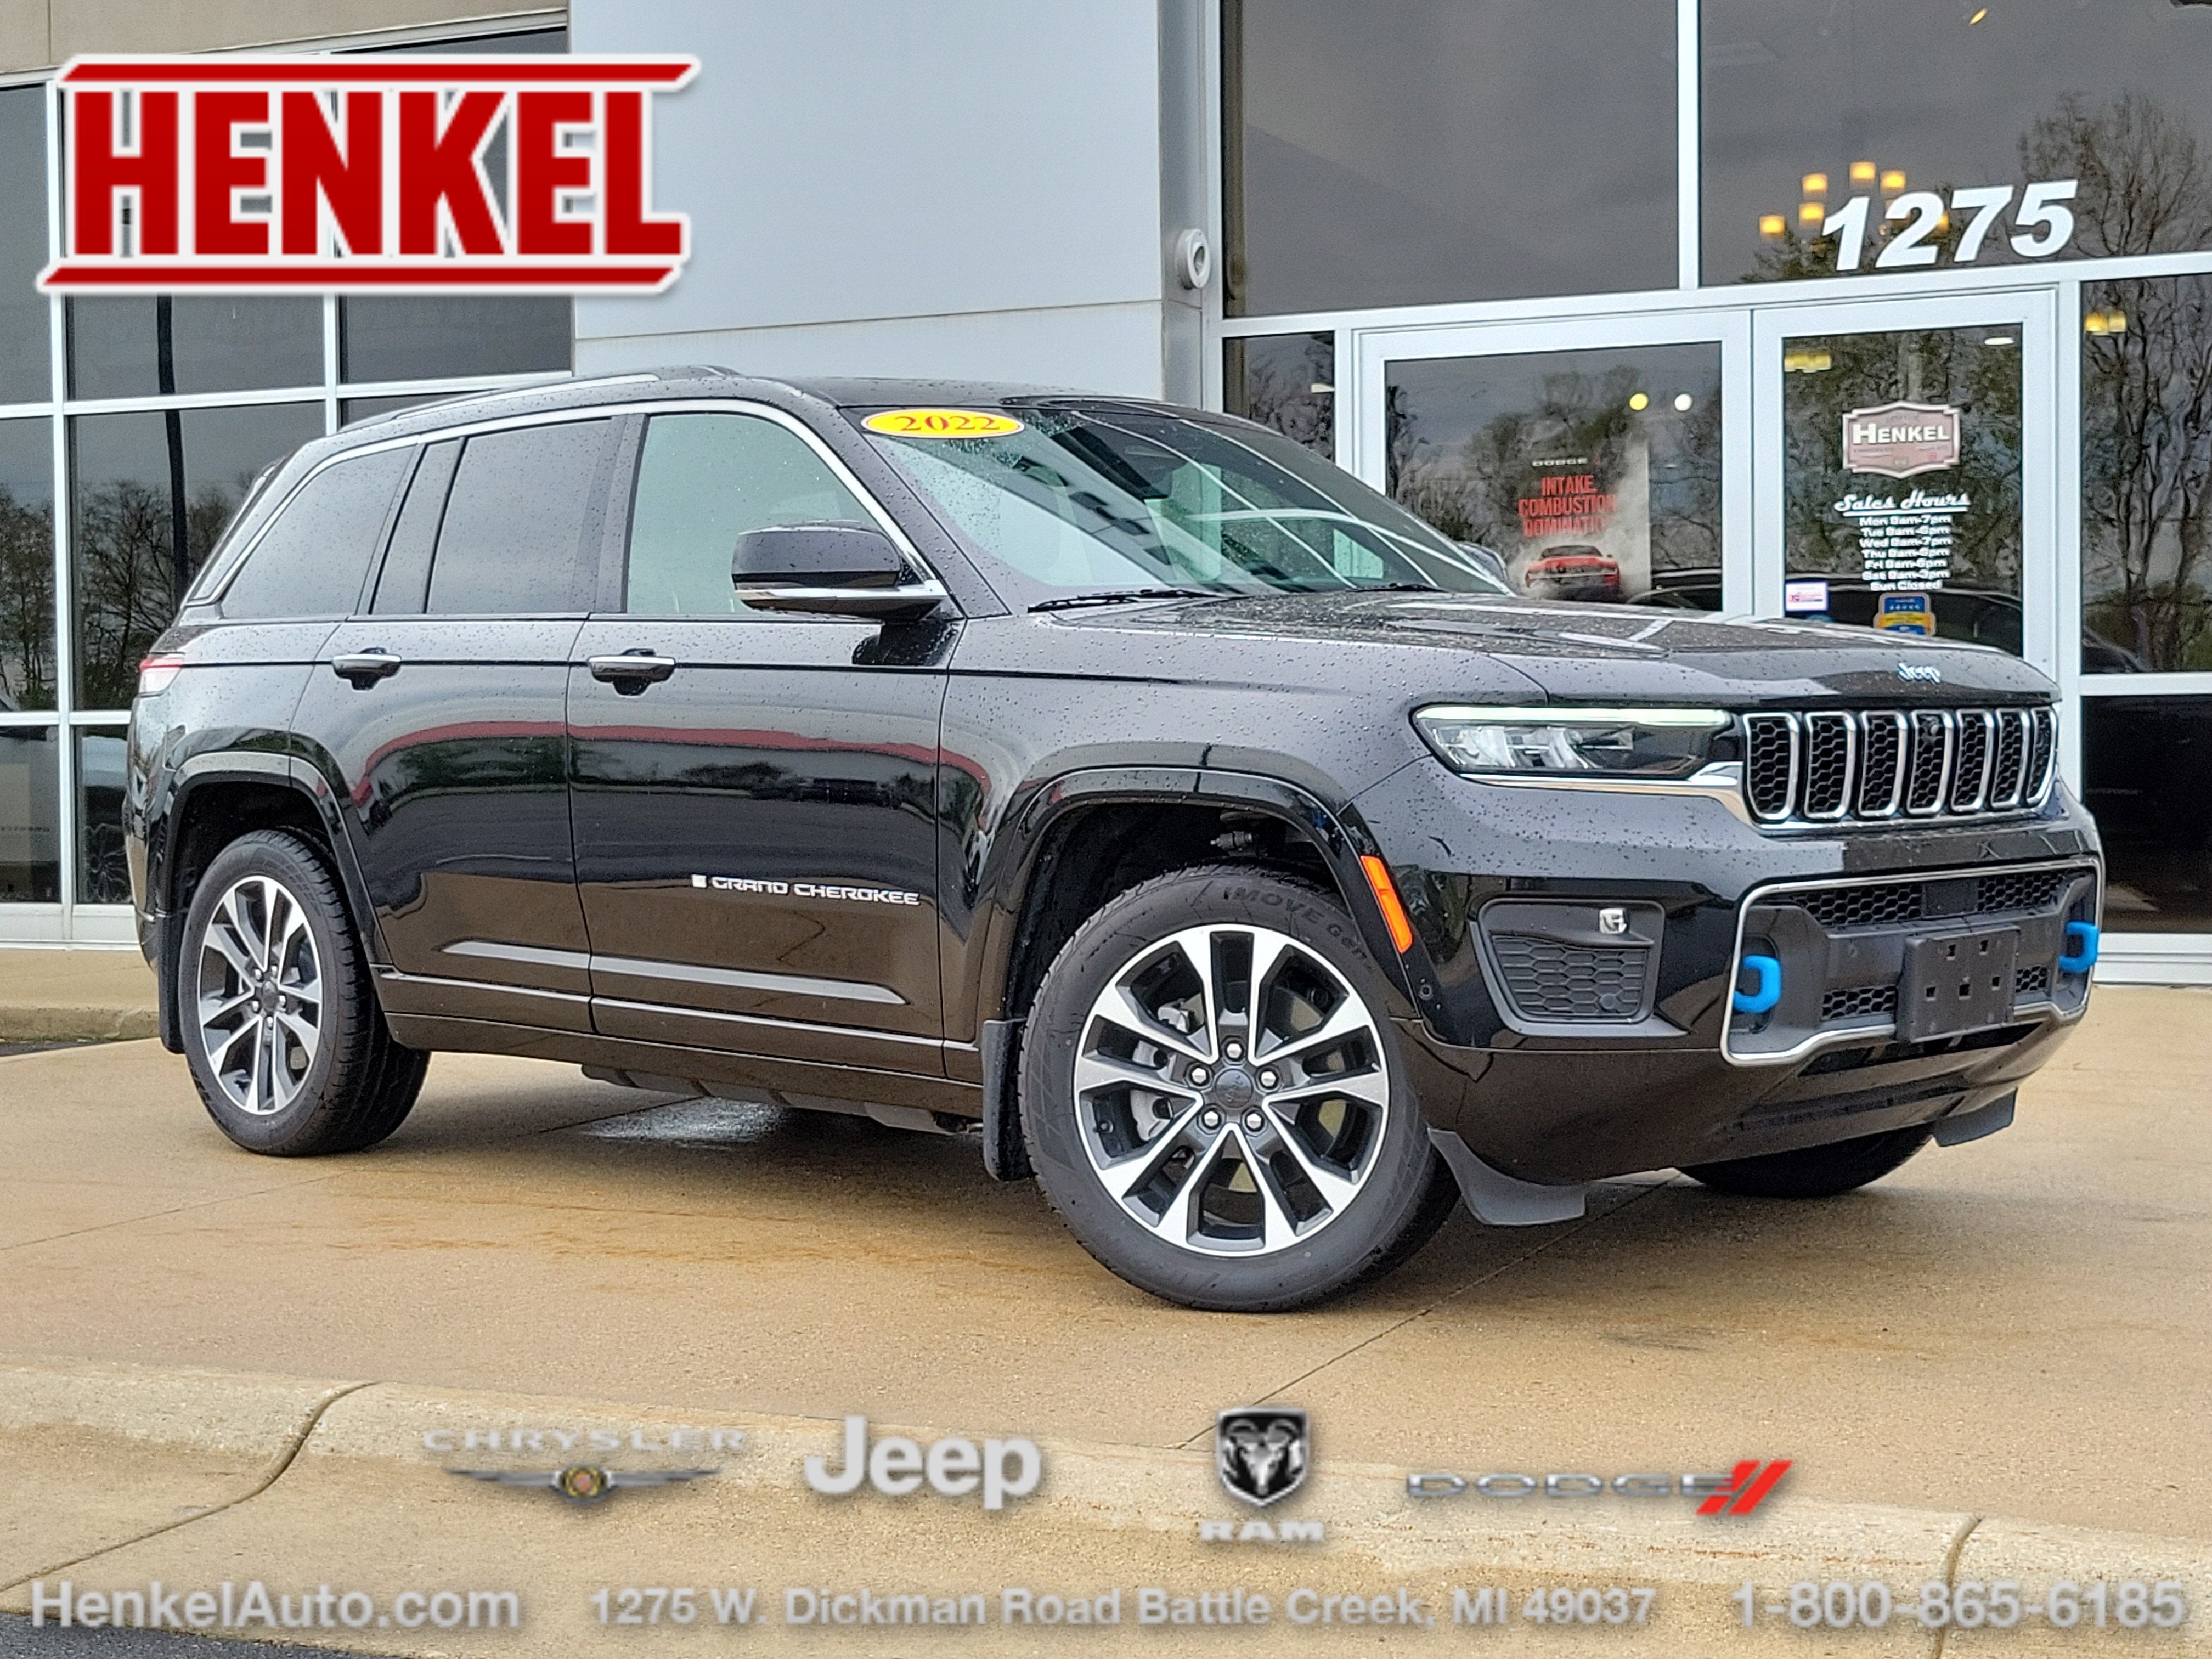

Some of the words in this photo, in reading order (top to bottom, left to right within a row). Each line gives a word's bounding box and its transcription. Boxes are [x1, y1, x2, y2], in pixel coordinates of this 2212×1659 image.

[1821, 179, 2079, 271] 1275
[895, 415, 1000, 431] 2022
[1852, 422, 1951, 444] HENKEL
[1532, 457, 1588, 466] DODGE
[1541, 474, 1598, 496] INTAKE
[1518, 495, 1616, 517] COMBUSTION
[1833, 494, 1897, 512] Sales
[1900, 489, 1971, 509] Hours
[1859, 516, 1888, 526] Mon
[1860, 527, 1884, 537] Tue
[1859, 538, 1889, 548] Wed
[1861, 549, 1887, 558] Thu
[1865, 560, 1883, 569] Fri
[1861, 571, 1886, 580] Sat
[1870, 582, 1897, 591] Sun
[1897, 580, 1943, 590] Closed
[1898, 662, 1941, 684] Jeep
[712, 876, 788, 895] GRAND
[793, 883, 920, 906] CHEROKEE
